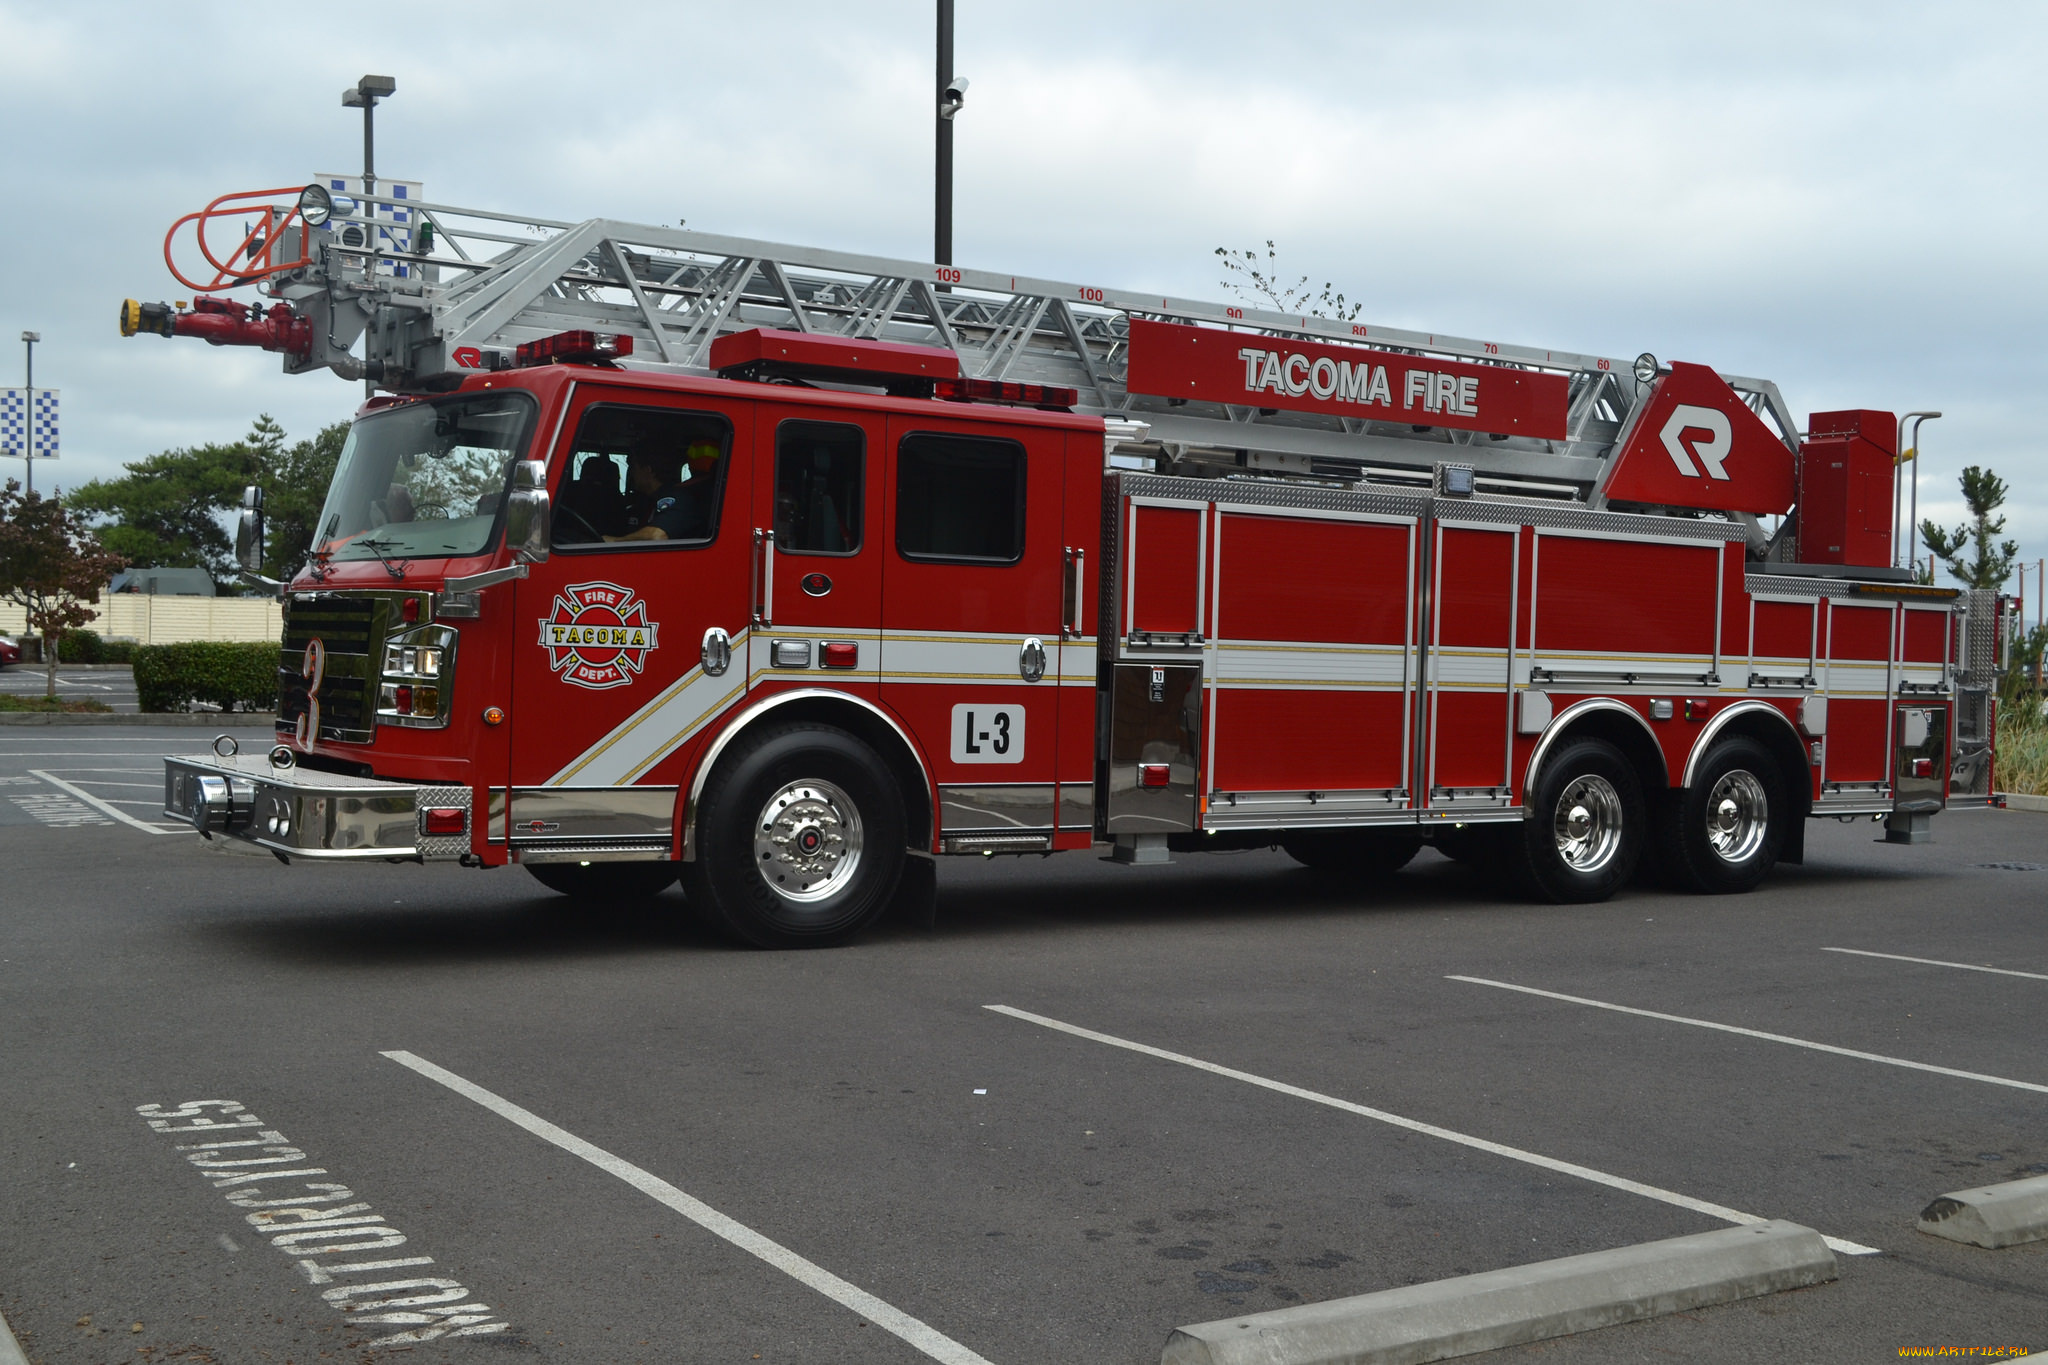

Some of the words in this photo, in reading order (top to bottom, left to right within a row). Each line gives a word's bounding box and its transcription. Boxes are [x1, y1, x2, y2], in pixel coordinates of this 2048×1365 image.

[935, 268, 961, 283] 109
[1078, 287, 1103, 302] 100
[1226, 307, 1243, 320] 90
[1352, 325, 1367, 337] 80
[1484, 343, 1498, 355] 70
[1597, 359, 1610, 371] 60
[1238, 348, 1392, 407] TACOMA
[1404, 369, 1480, 418] FIRE
[584, 591, 616, 604] FIRE
[551, 626, 645, 645] TACOMA
[578, 667, 617, 680] DEPT.
[966, 711, 1010, 755] L-3
